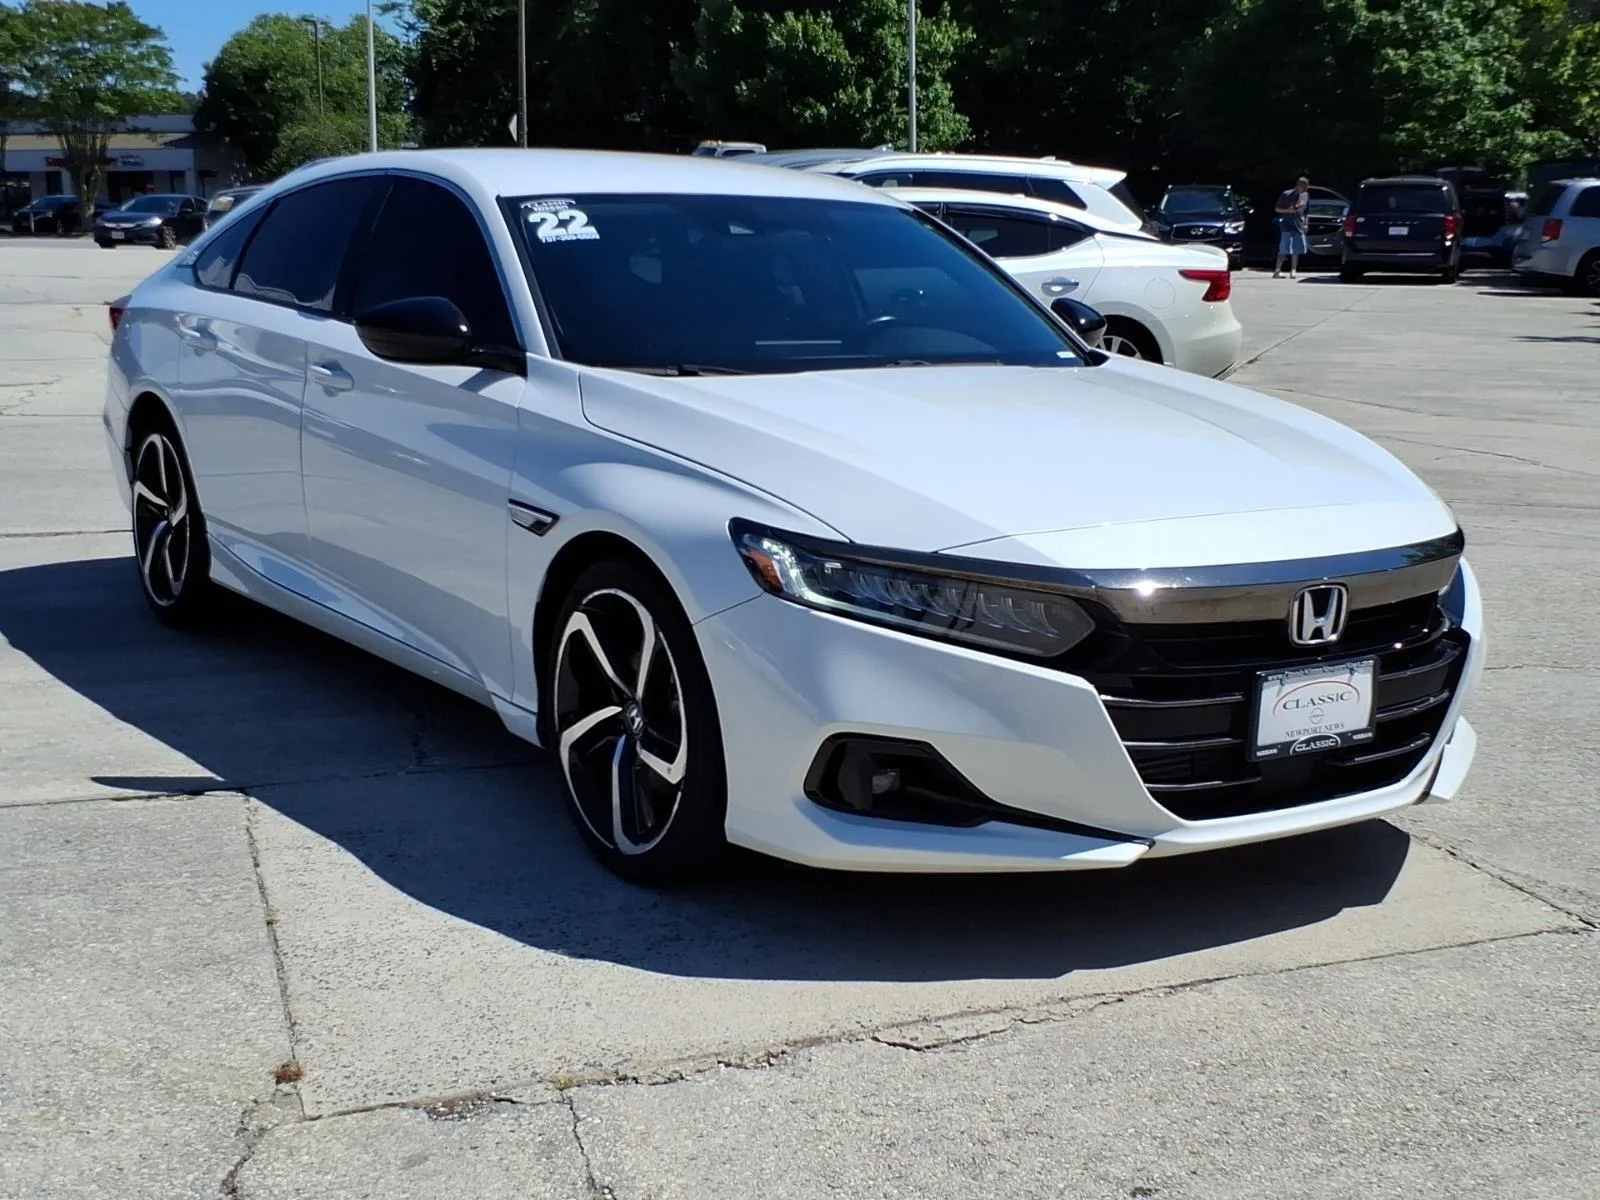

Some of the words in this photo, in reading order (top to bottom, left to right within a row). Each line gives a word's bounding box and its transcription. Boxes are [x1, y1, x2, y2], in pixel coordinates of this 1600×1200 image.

[528, 209, 599, 240] 22
[1282, 690, 1352, 711] CLASSIC
[1285, 725, 1324, 738] NEWPORT
[1324, 722, 1345, 732] NEWS
[1294, 738, 1338, 752] CLASSIC
